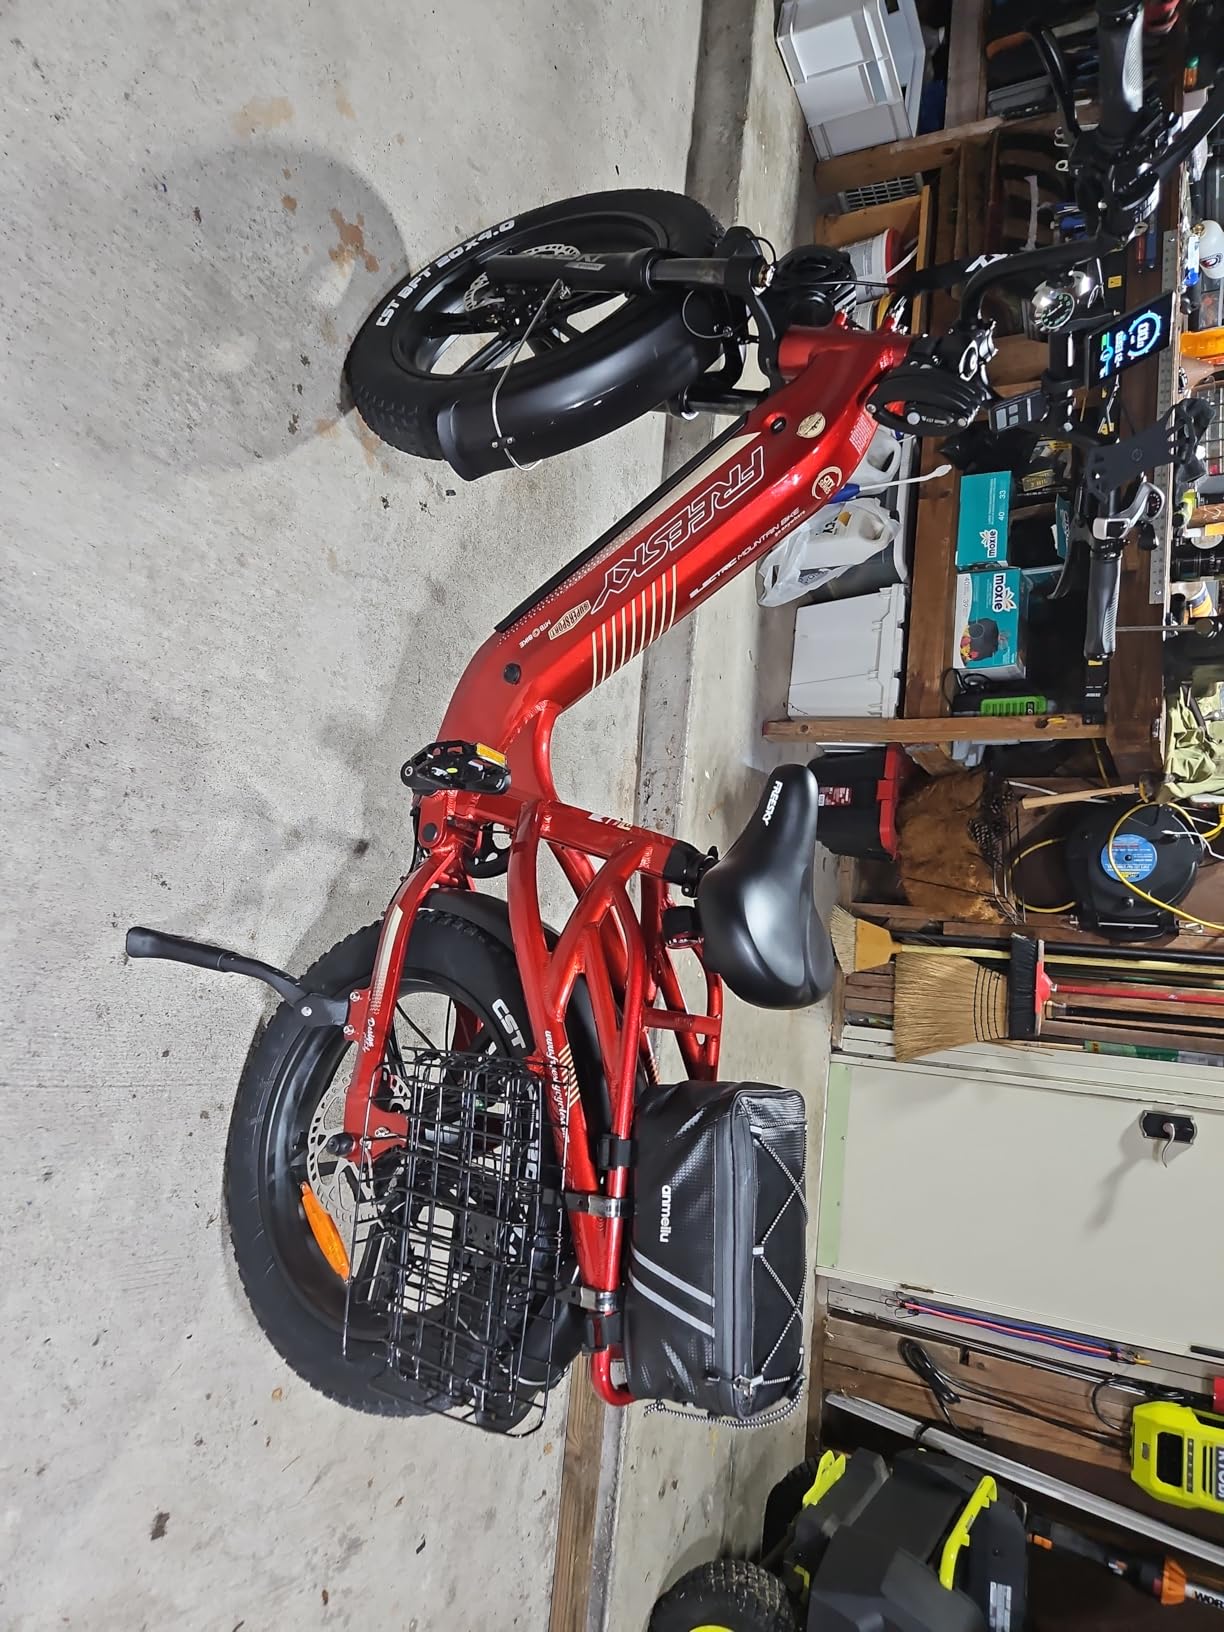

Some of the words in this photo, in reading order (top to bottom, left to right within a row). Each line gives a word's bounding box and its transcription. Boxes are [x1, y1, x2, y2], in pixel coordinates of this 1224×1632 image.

[375, 299, 400, 327] CST
[397, 267, 432, 299] BFT
[999, 489, 1007, 499] 33
[590, 446, 764, 615] FREESKY
[998, 511, 1006, 520] 40
[988, 529, 997, 557] moxie
[689, 558, 738, 599] ELECTRIC
[993, 574, 1005, 611] moxie
[518, 634, 533, 649] BIKE
[762, 780, 784, 826] FREESKY
[490, 998, 527, 1049] CST
